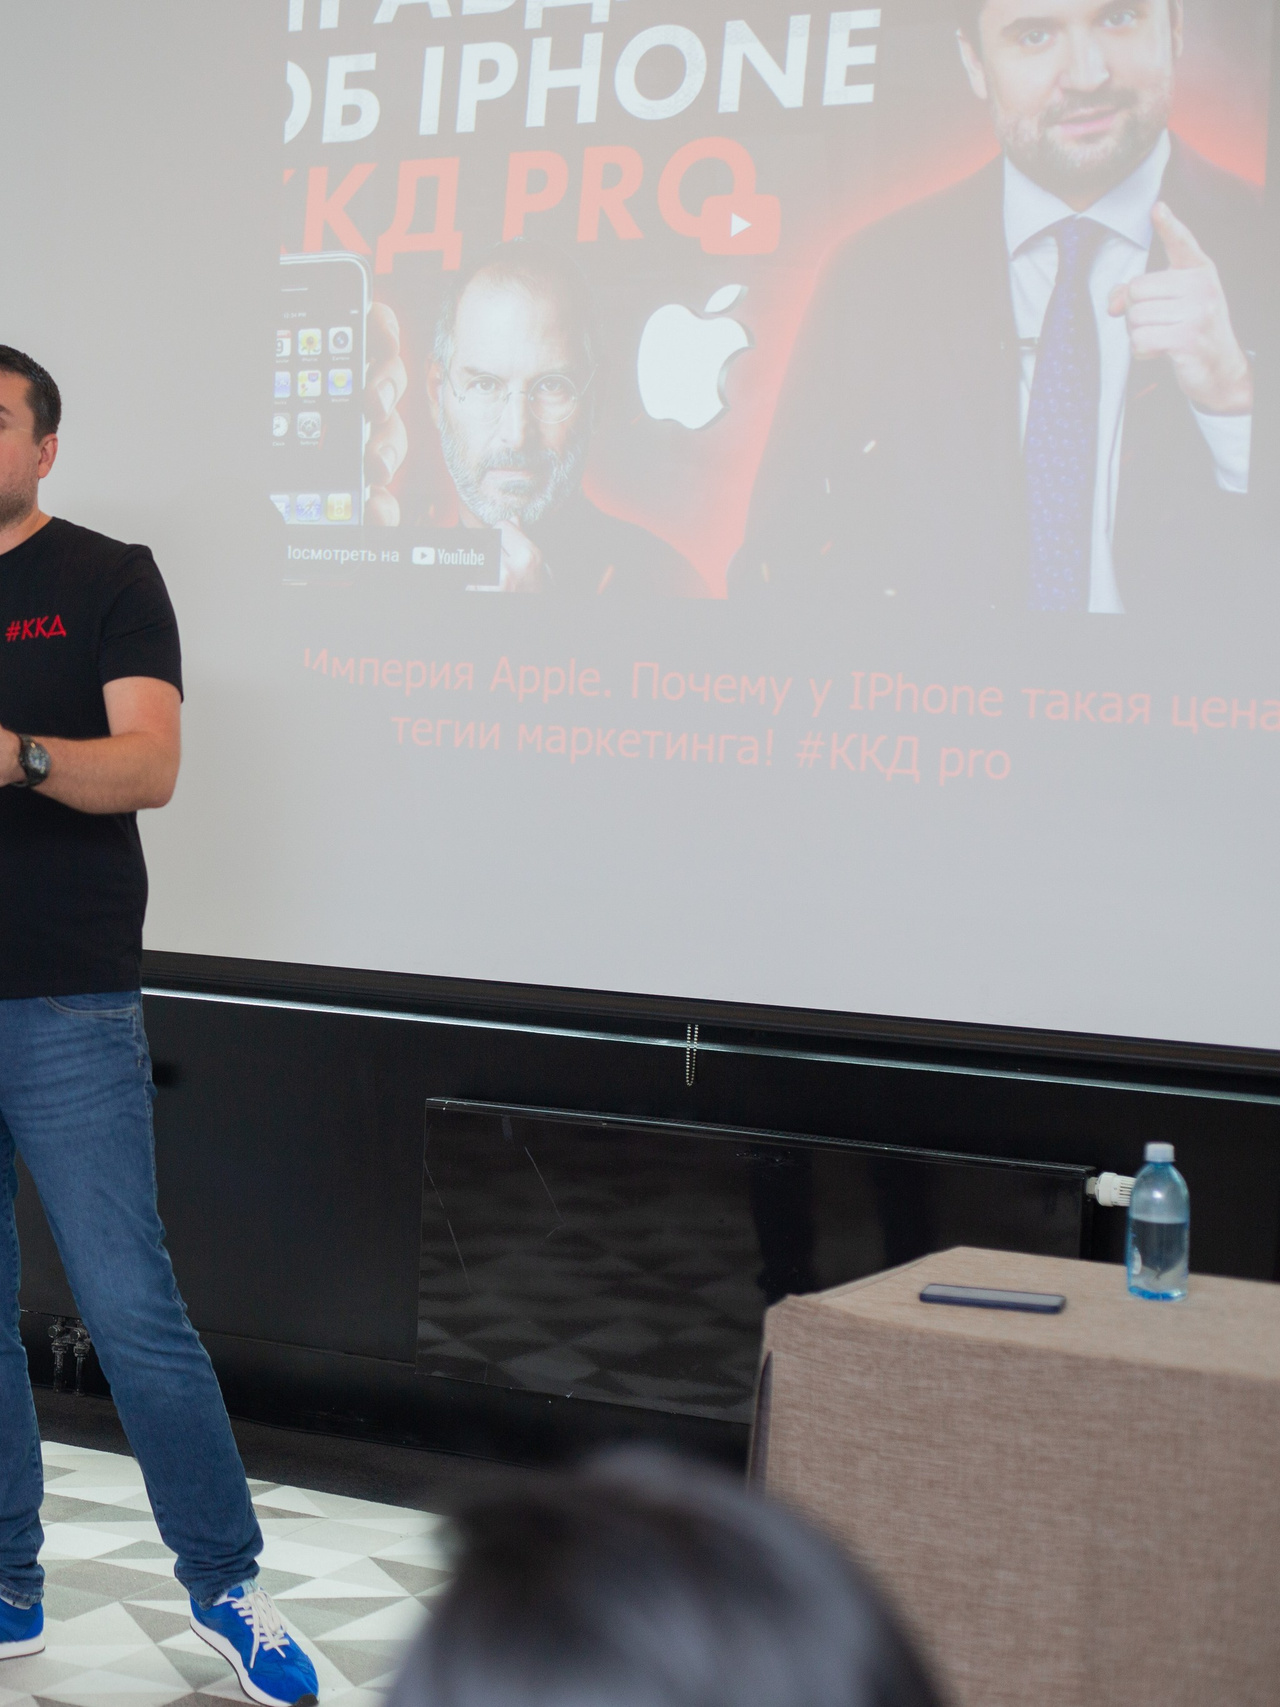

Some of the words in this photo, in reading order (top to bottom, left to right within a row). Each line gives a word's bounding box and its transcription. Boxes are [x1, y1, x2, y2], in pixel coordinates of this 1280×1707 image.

[419, 8, 881, 136] IPHONE
[282, 157, 463, 274] КД
[502, 136, 757, 243] PRO
[381, 550, 400, 563] на
[437, 548, 485, 566] YouTube
[5, 614, 67, 642] #ККД
[490, 656, 612, 702] Apple.
[632, 662, 793, 716] Почему
[809, 677, 833, 718] у
[850, 671, 1004, 717] IPhone
[1022, 686, 1151, 725] такая
[391, 716, 502, 750] тегии
[519, 723, 775, 766] маркетинга!
[796, 731, 920, 784] #ККД
[939, 746, 1012, 786] pro
